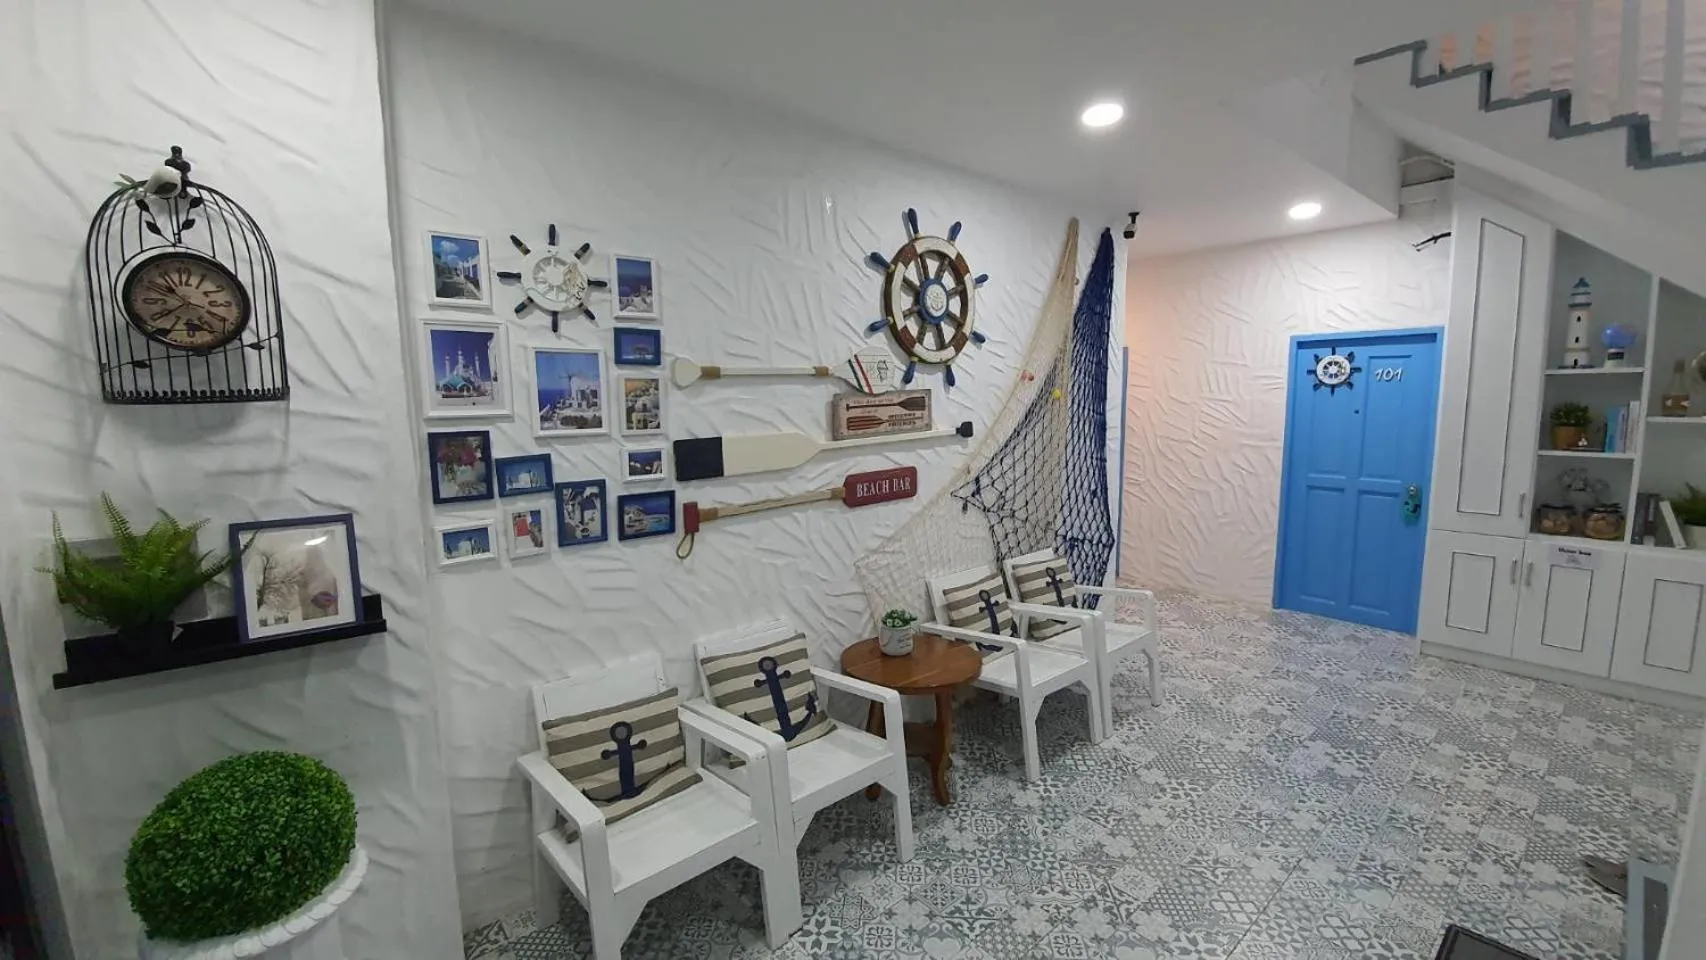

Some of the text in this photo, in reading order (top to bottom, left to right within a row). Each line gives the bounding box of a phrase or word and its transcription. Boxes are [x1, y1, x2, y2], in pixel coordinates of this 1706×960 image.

[176, 266, 193, 288] 12
[195, 273, 207, 290] 1
[203, 285, 225, 297] 2
[208, 300, 232, 308] 3
[206, 309, 228, 335] 4
[1375, 367, 1402, 381] 101
[856, 476, 911, 498] BEACH BAR
